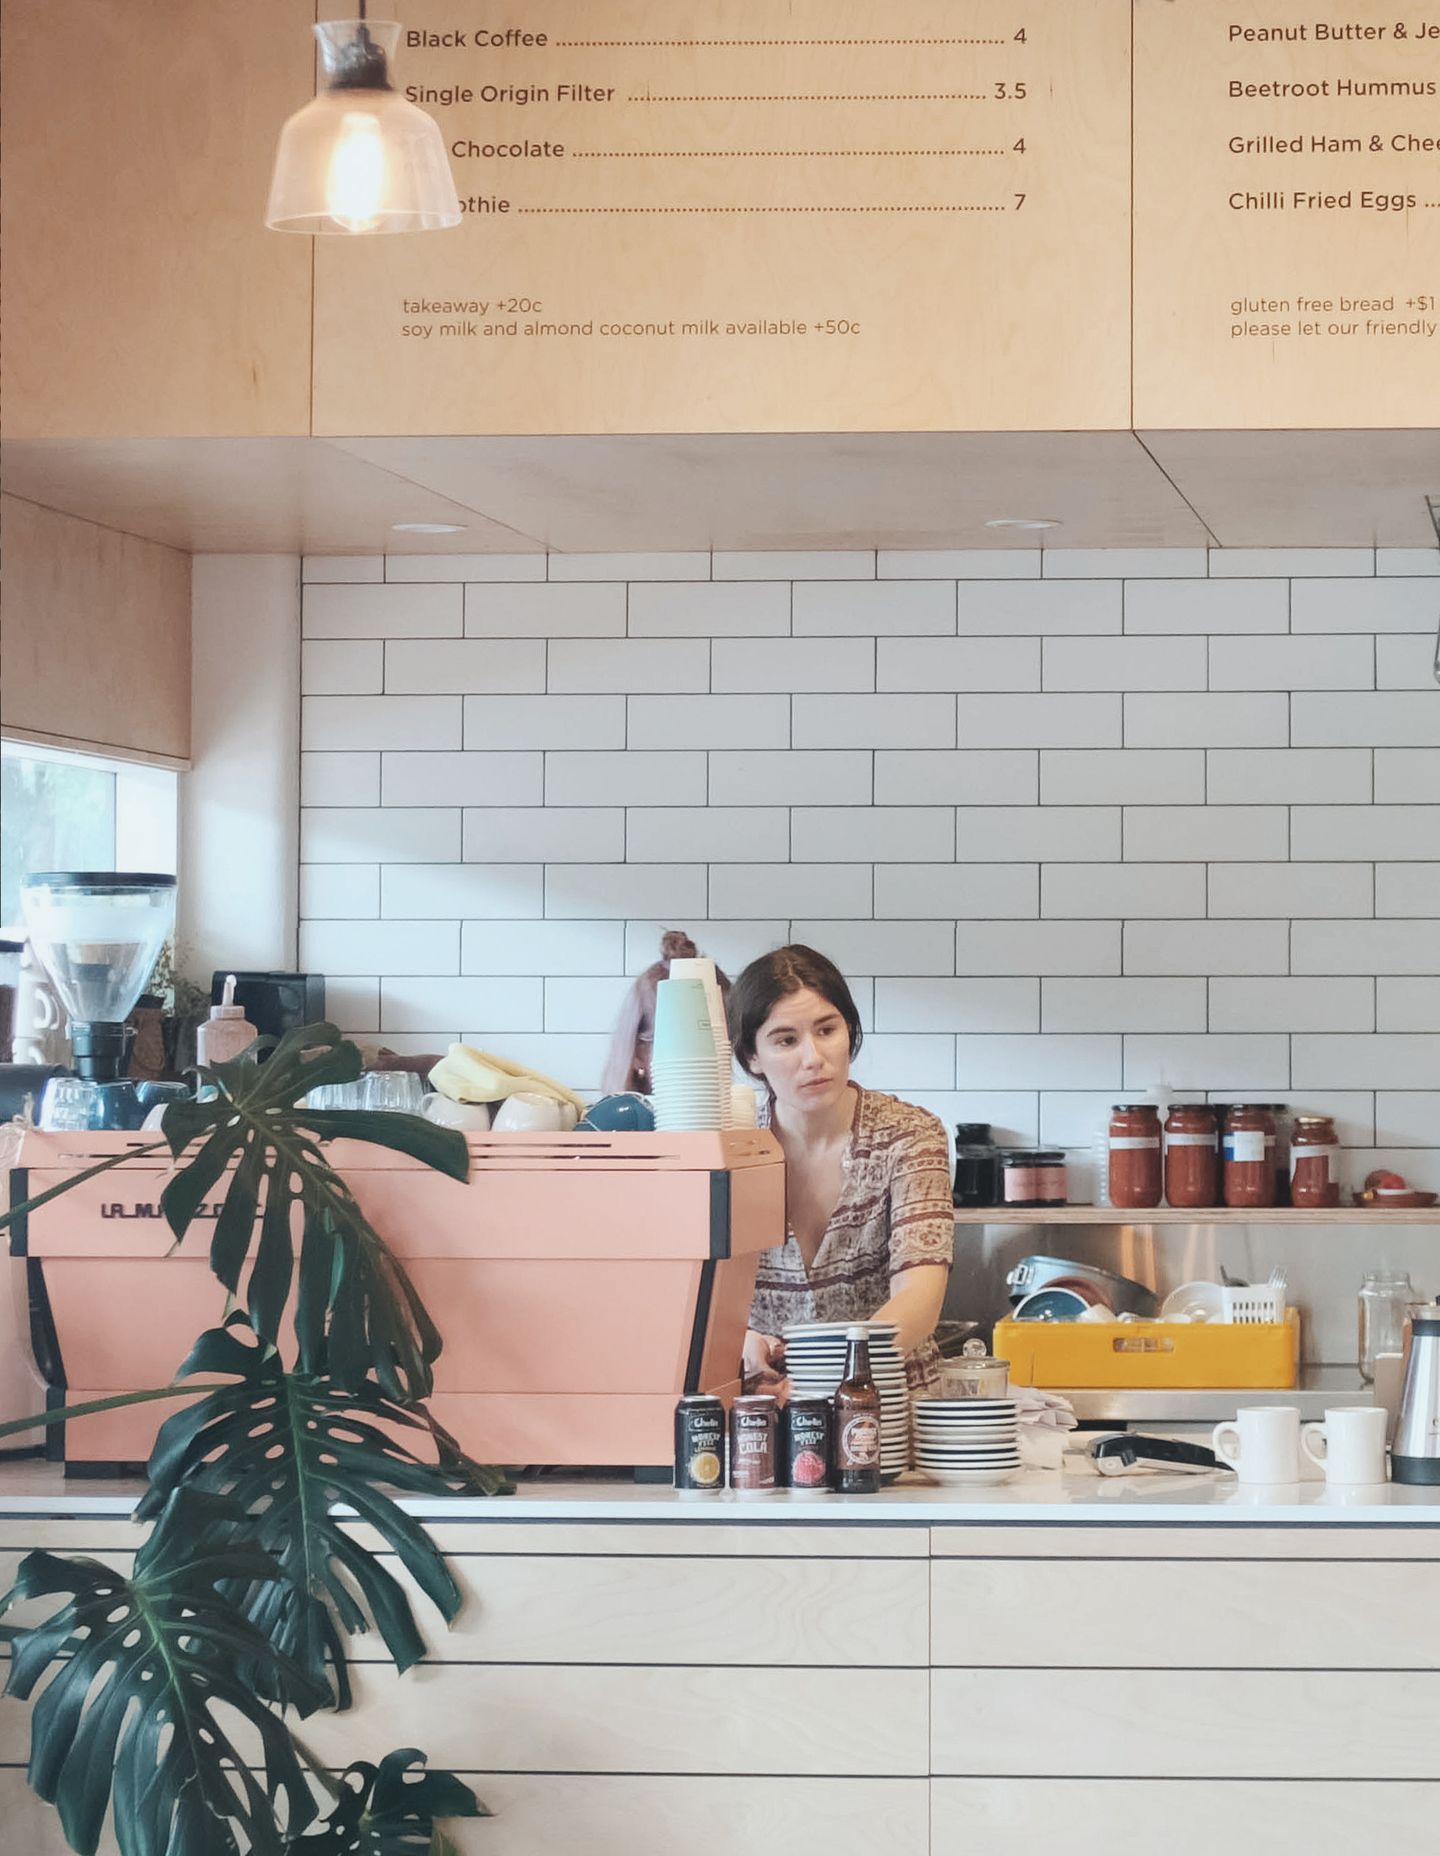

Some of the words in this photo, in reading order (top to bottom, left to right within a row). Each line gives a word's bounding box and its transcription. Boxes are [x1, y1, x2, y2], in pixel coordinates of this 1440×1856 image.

[406, 30, 466, 47] Black
[474, 29, 548, 47] Coffee
[1013, 27, 1027, 45] 4
[1229, 24, 1308, 42] Peanut
[1315, 23, 1386, 41] Butter
[1393, 22, 1407, 39] &
[405, 84, 474, 107] Single
[480, 84, 549, 106] Origin
[557, 83, 616, 103] Filter
[994, 82, 1027, 100] 3.5
[1229, 80, 1331, 98] Beetroot
[1337, 79, 1437, 97] Hummus
[451, 140, 565, 158] Chocolate
[1013, 138, 1027, 155] 4
[1229, 135, 1303, 153] Grilled
[1311, 135, 1361, 153] Ham
[1369, 135, 1383, 152] &
[453, 195, 511, 214] othie
[1014, 194, 1027, 211] 7
[1229, 192, 1284, 210] Chilli
[1293, 191, 1352, 209] Fried
[1360, 190, 1417, 211] Eggs
[402, 298, 490, 316] takeaway
[496, 298, 543, 313] +20c
[1231, 297, 1290, 315] gluten
[1297, 297, 1334, 312] free
[1340, 296, 1395, 312] bread
[1405, 295, 1435, 312] +$1
[401, 324, 434, 341] soy
[440, 320, 477, 336] milk
[483, 321, 517, 336] and
[524, 320, 593, 336] almond
[600, 320, 676, 336] coconut
[682, 319, 719, 335] milk
[726, 319, 807, 335] available
[814, 319, 861, 334] +50c
[1231, 320, 1292, 339] please
[1298, 320, 1322, 336] let
[1328, 324, 1360, 336] our
[1366, 319, 1437, 338] friendly
[739, 1442, 768, 1454] COLA
